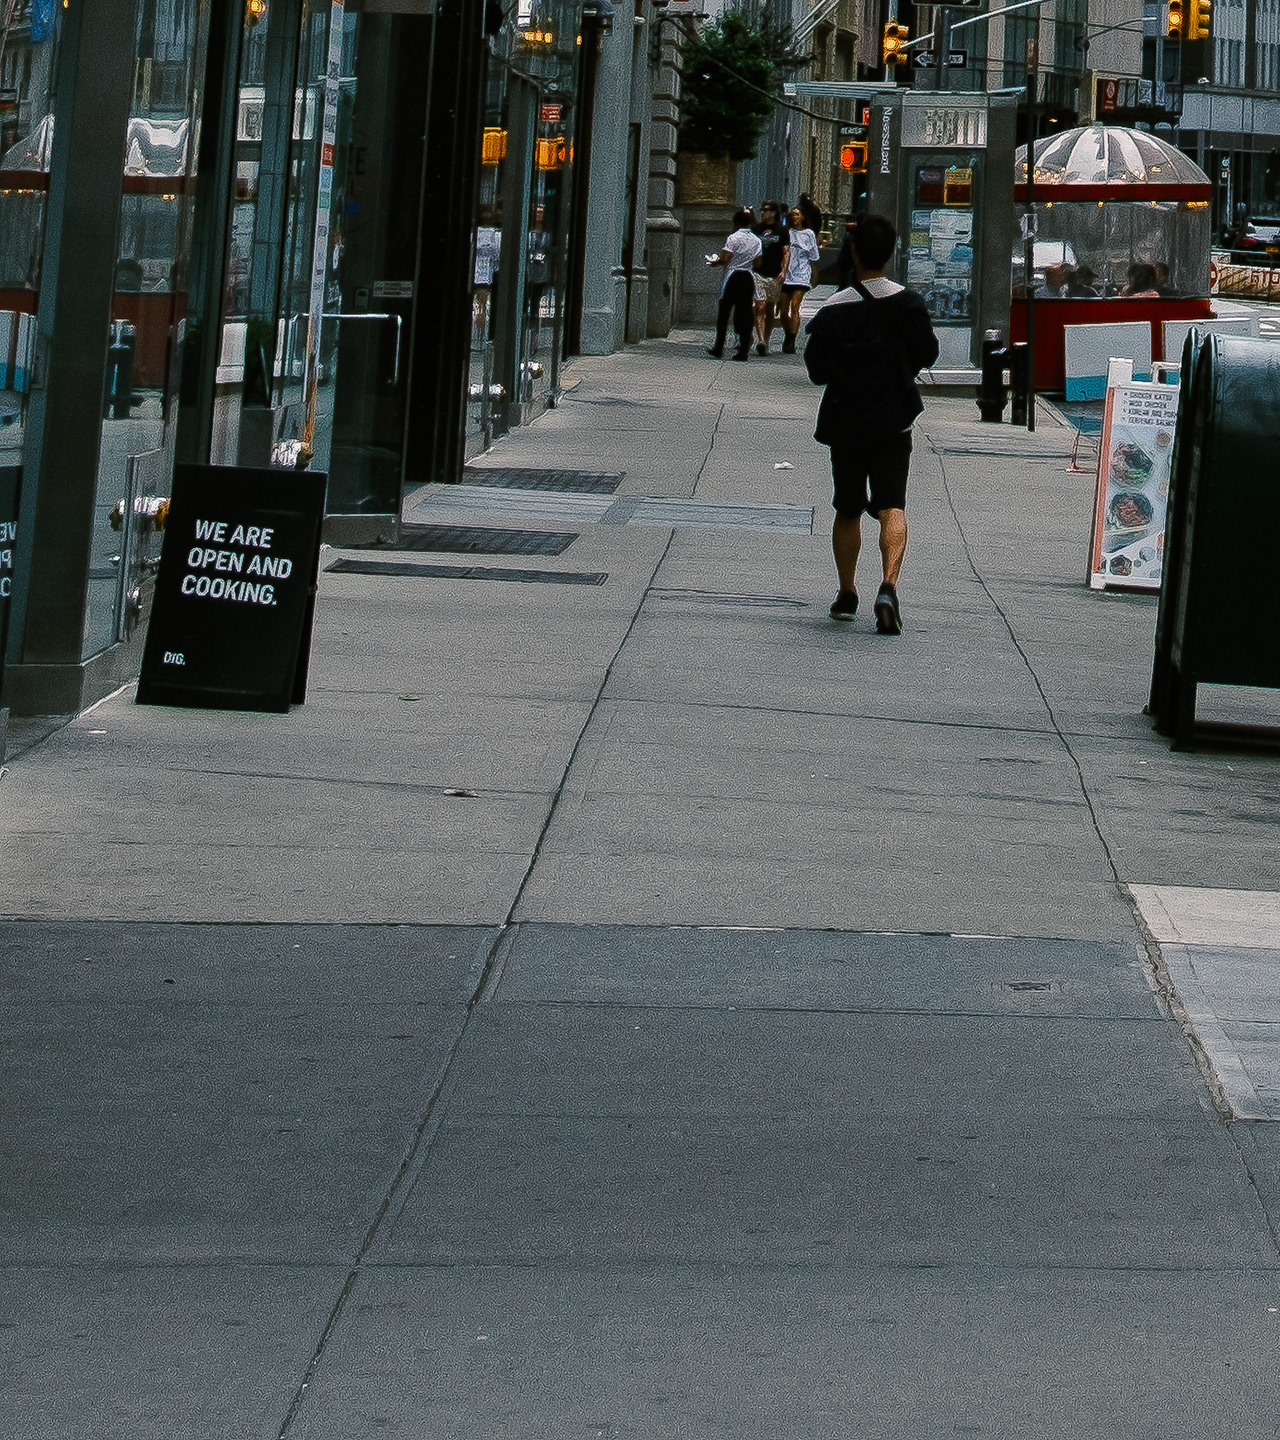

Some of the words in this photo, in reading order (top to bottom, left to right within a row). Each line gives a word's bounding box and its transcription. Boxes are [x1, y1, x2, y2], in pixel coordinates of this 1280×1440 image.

[196, 519, 228, 542] WE
[229, 524, 274, 548] ARE
[187, 547, 244, 573] OPEN
[246, 555, 293, 579] AND
[181, 574, 277, 605] COOKING.
[163, 651, 186, 665] DIG.
